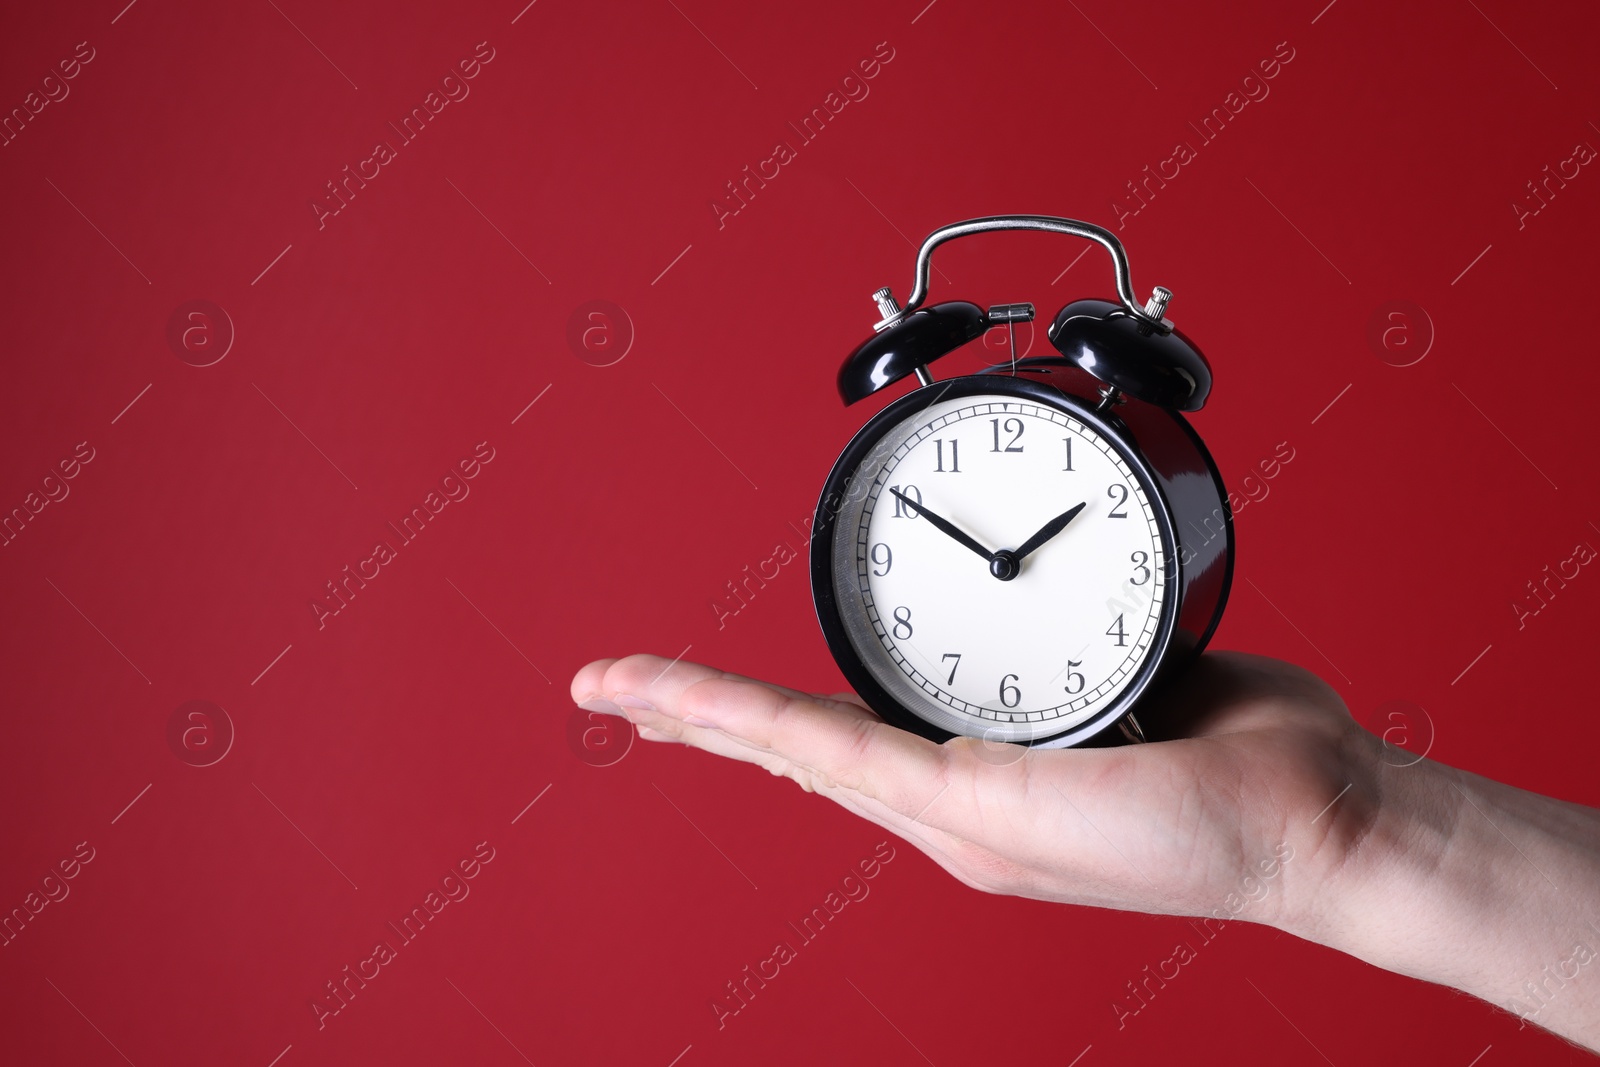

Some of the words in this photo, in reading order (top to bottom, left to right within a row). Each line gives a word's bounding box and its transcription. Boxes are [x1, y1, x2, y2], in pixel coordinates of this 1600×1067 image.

[989, 417, 1025, 453] 12
[932, 438, 962, 473] 11
[1062, 437, 1077, 472] 1
[890, 484, 923, 519] 10
[1107, 483, 1129, 519] 2
[870, 542, 893, 577] 9
[1129, 550, 1151, 586] 3
[891, 606, 914, 640] 8
[1105, 613, 1130, 647] 4
[941, 653, 962, 686] 7
[1064, 659, 1086, 694] 5
[998, 673, 1022, 708] 6
